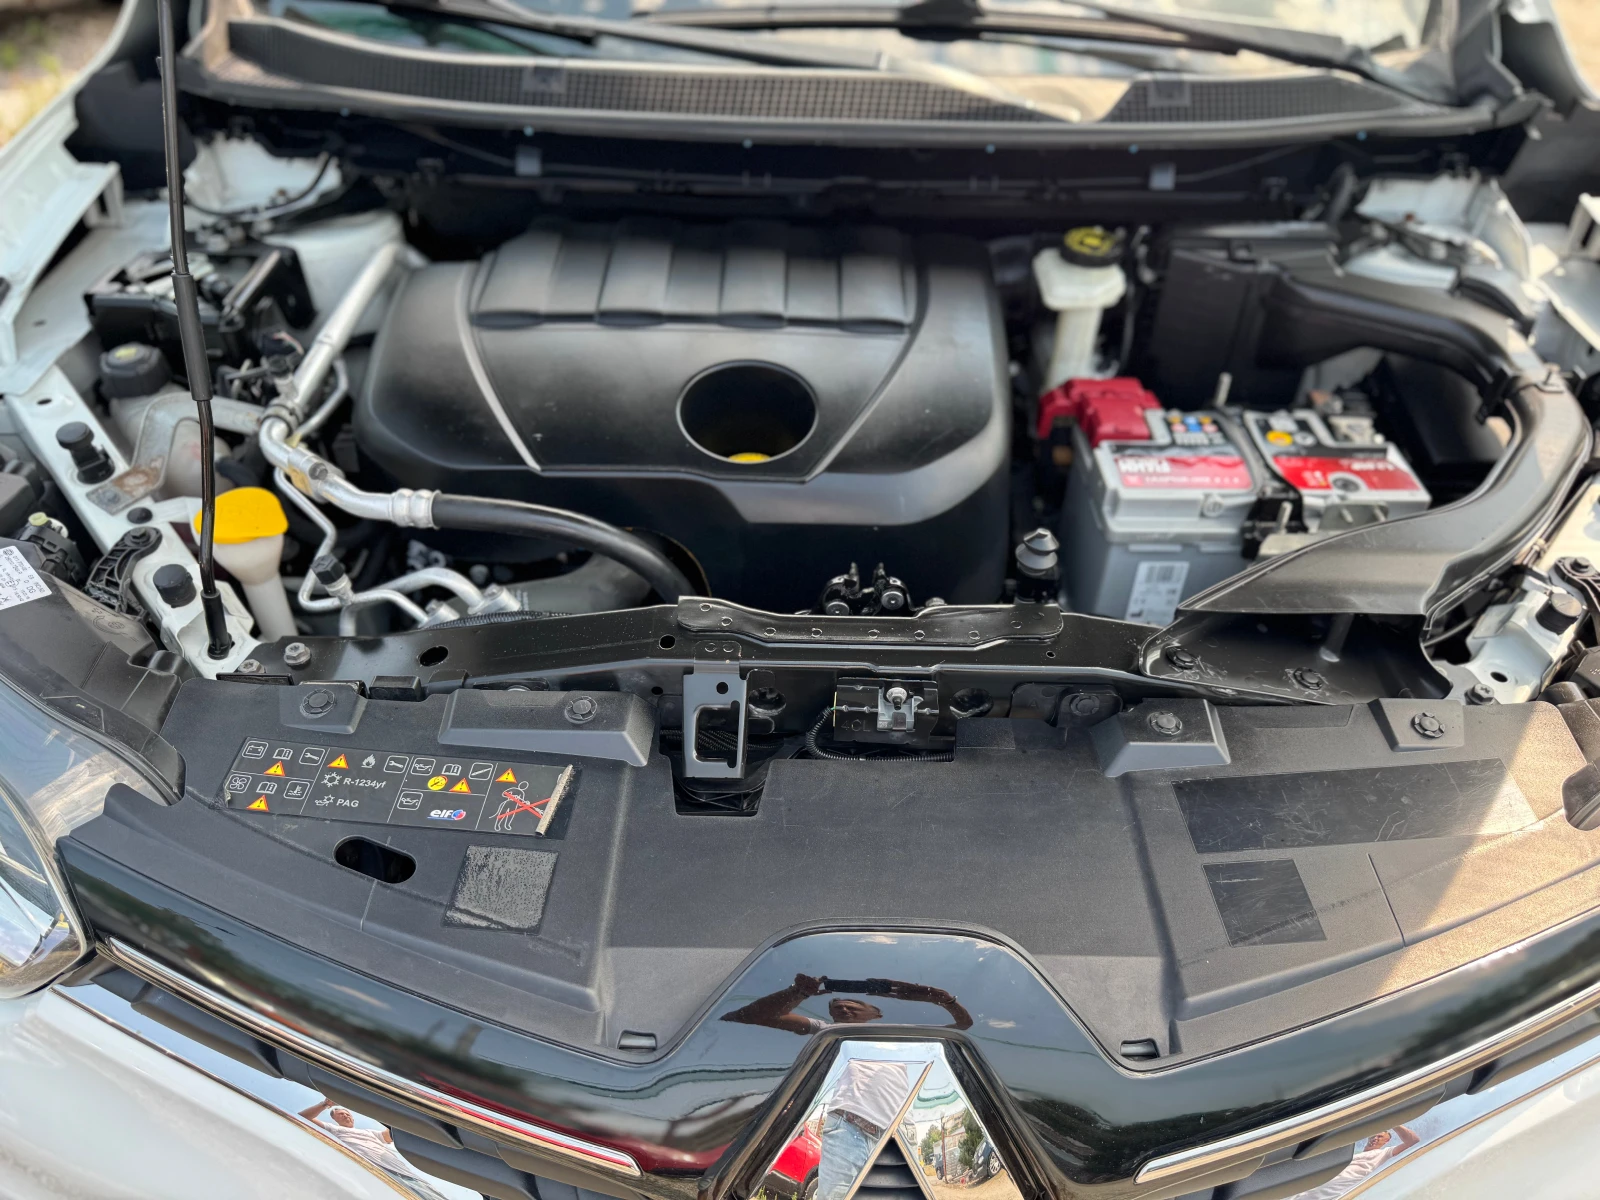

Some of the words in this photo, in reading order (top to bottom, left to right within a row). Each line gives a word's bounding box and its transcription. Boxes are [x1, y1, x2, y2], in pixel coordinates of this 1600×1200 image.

[343, 778, 387, 789] R-1234yf
[336, 798, 359, 808] PAG
[430, 809, 454, 818] elf
